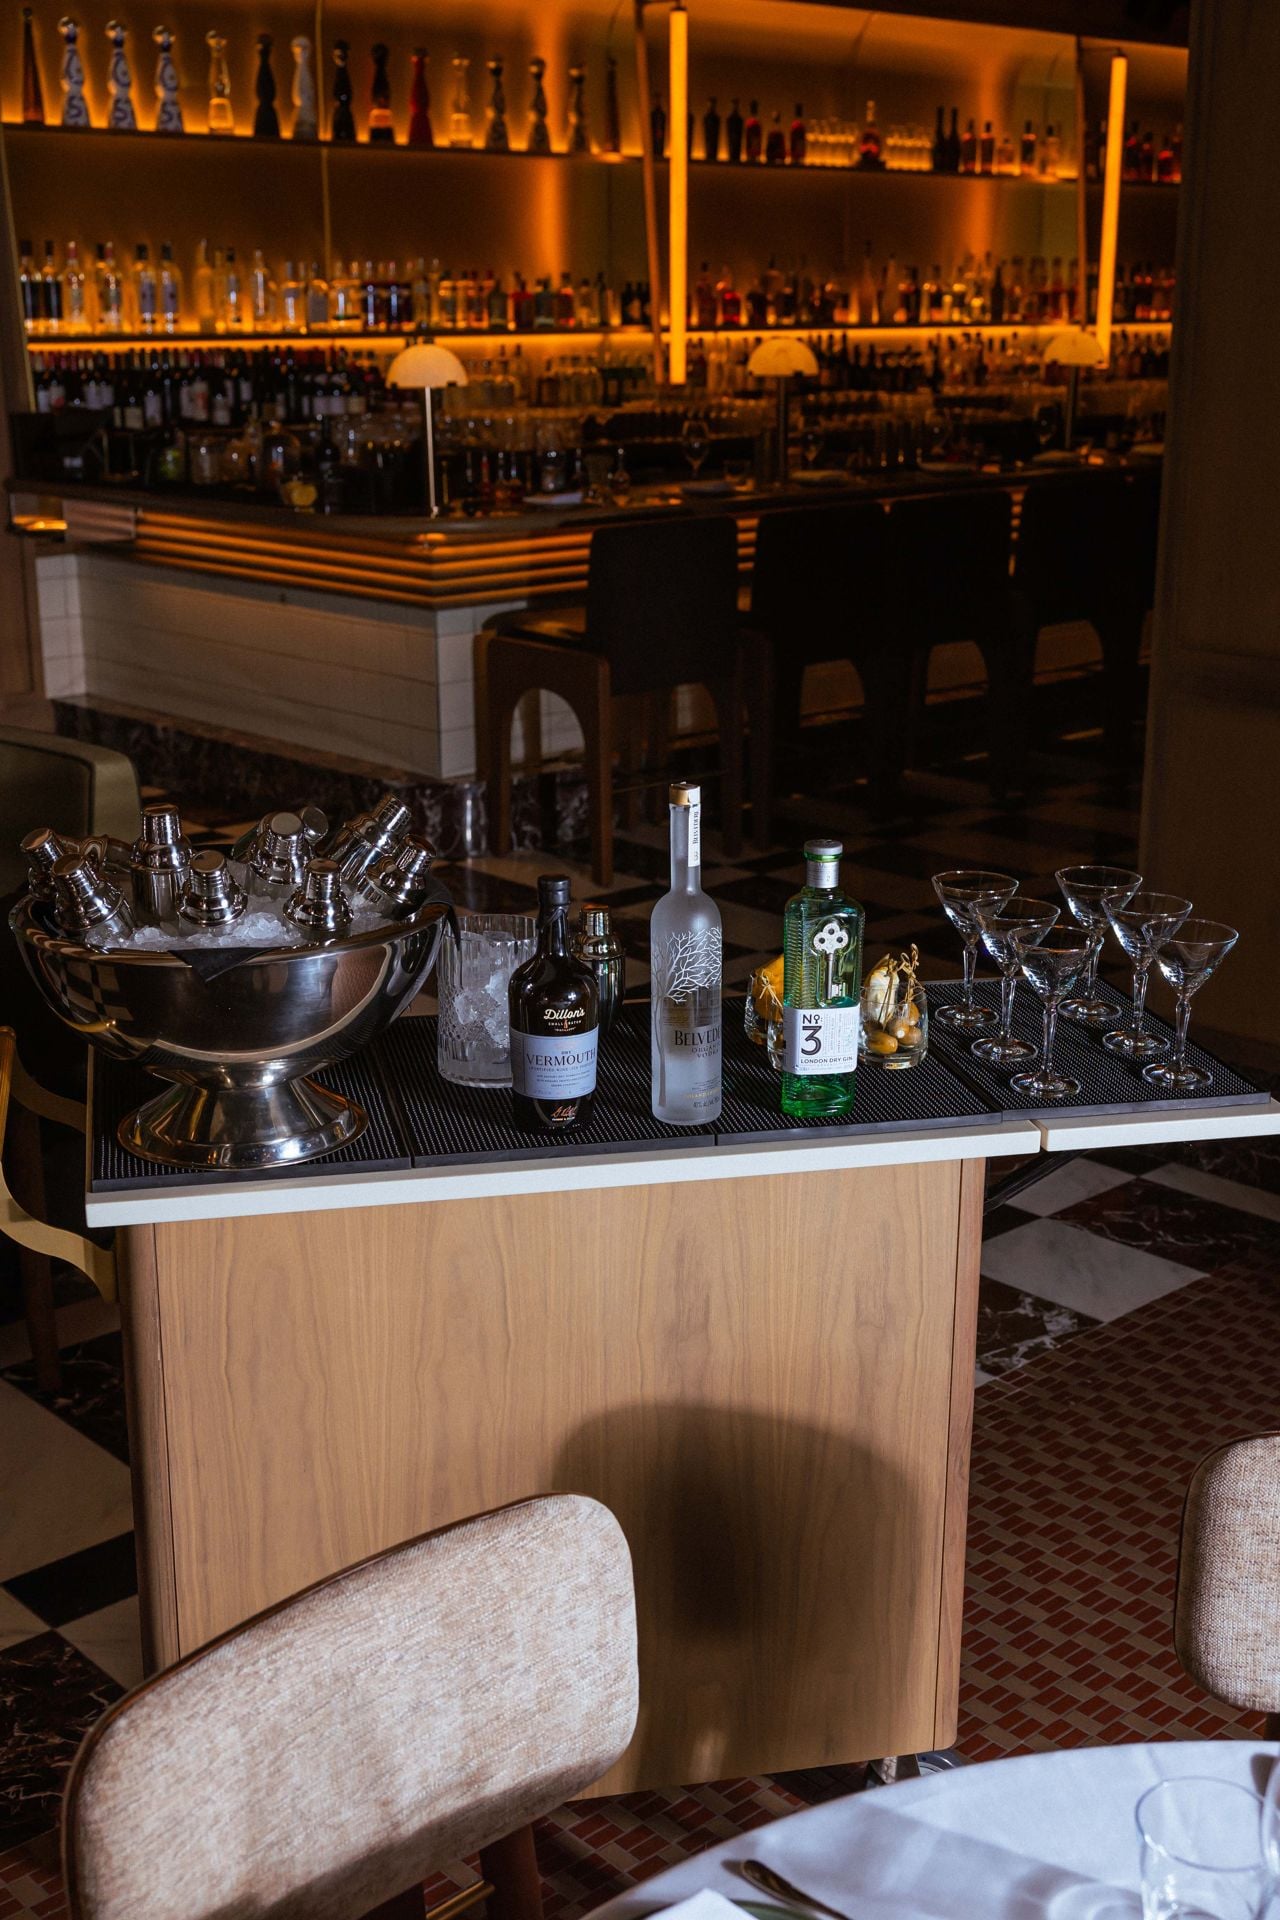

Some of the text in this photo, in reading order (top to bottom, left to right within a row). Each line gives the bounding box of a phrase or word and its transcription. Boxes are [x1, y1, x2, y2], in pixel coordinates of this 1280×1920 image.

[543, 1007, 586, 1020] Dillon's
[801, 1025, 822, 1056] 3
[526, 1047, 596, 1067] VERMOUTH
